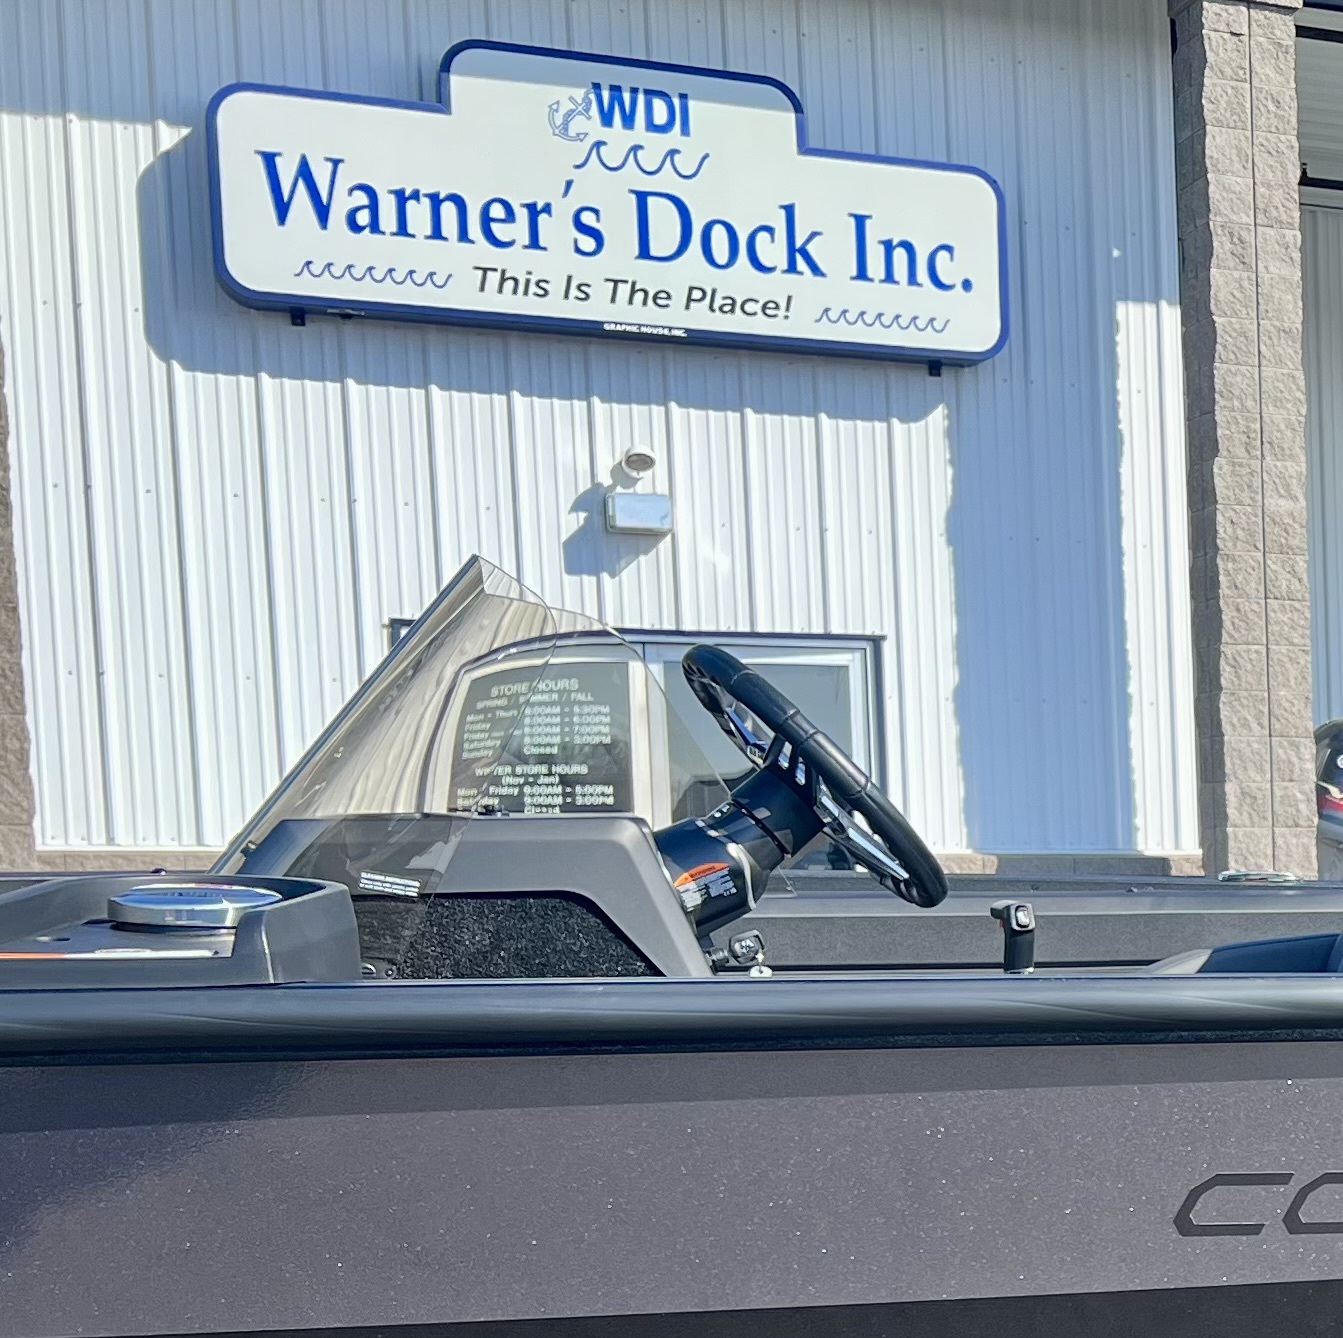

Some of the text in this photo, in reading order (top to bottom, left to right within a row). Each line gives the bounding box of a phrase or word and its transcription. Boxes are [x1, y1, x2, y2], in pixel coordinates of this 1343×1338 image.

[592, 82, 691, 137] WDI
[254, 150, 973, 293] Warner's Dock Inc.
[472, 266, 793, 320] This Is The Place!
[491, 678, 579, 697] STORE HOURS
[519, 693, 558, 703] SMMER
[571, 692, 594, 702] FALL
[515, 764, 549, 775] STORE
[552, 764, 588, 775] HOURS
[489, 786, 519, 796] Friday
